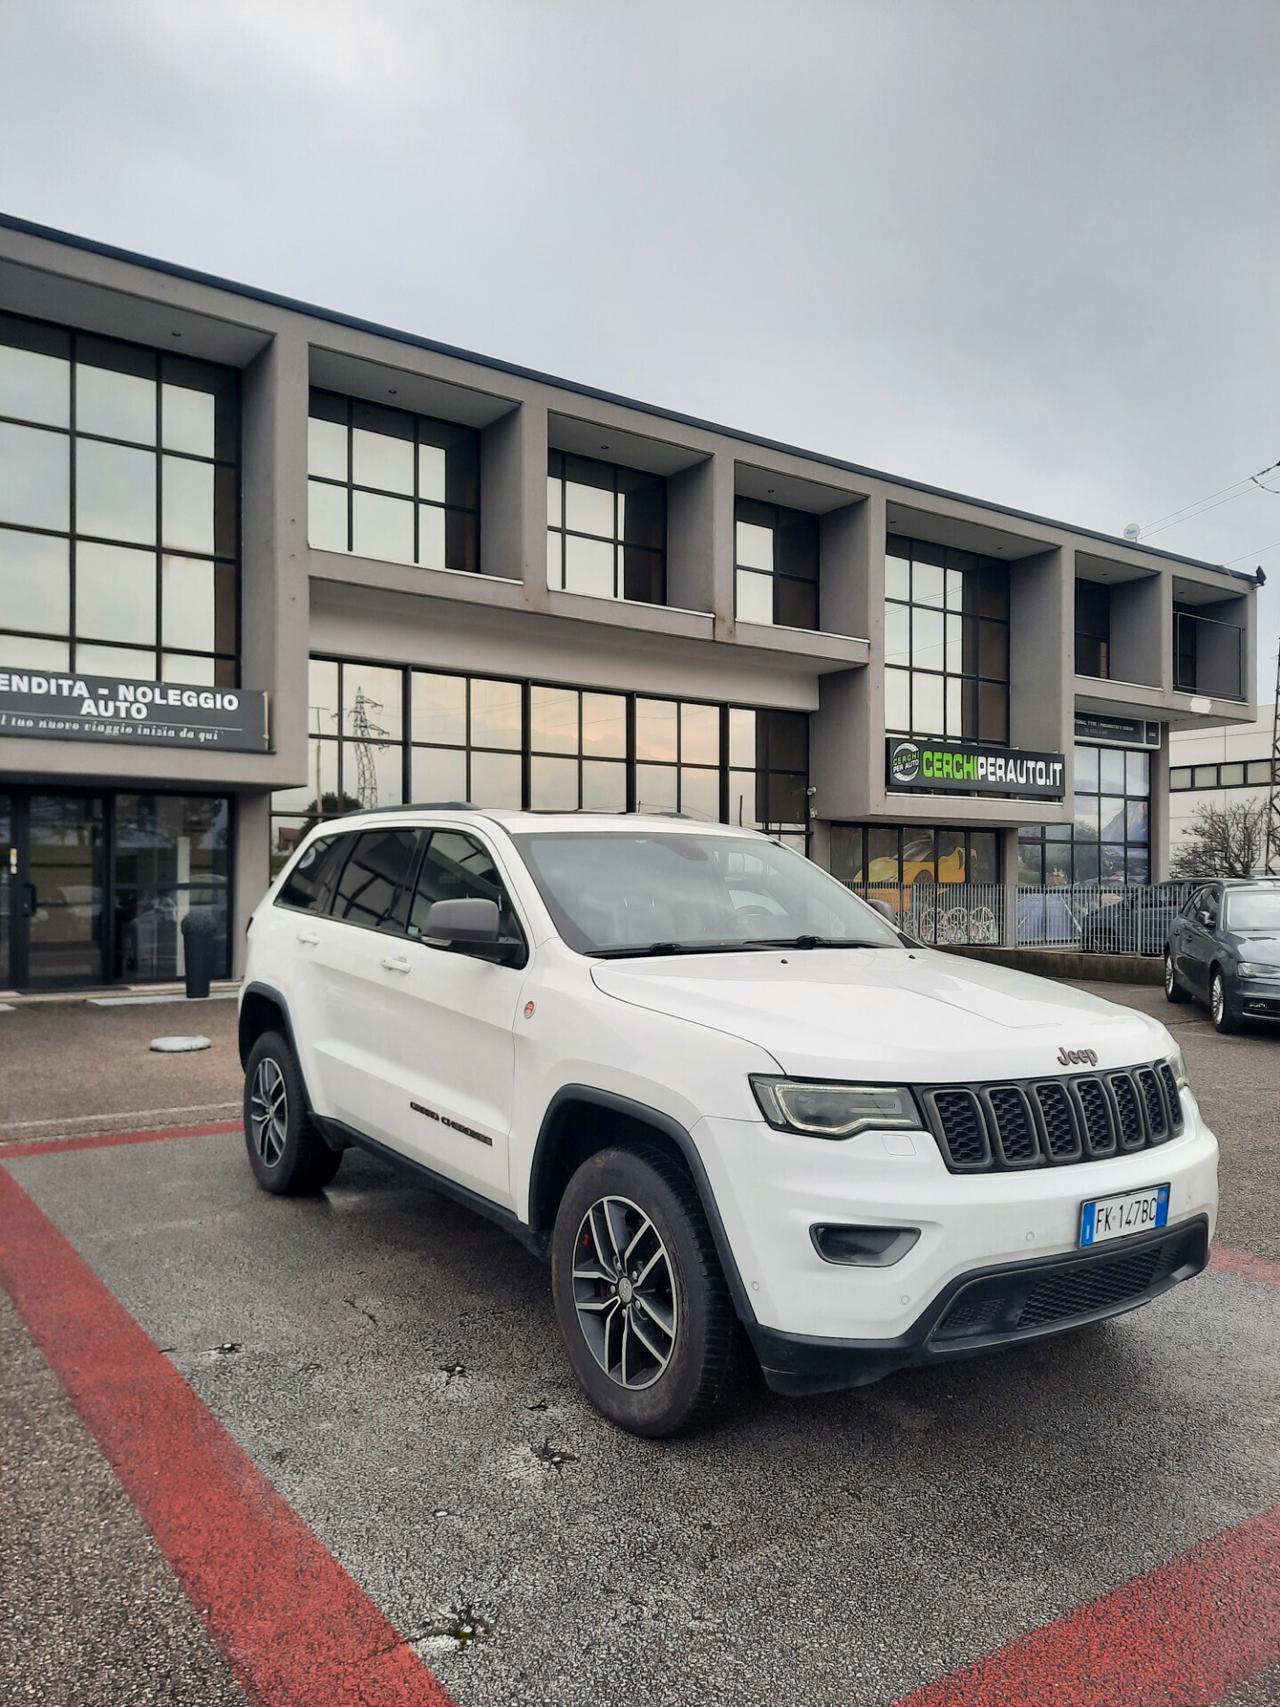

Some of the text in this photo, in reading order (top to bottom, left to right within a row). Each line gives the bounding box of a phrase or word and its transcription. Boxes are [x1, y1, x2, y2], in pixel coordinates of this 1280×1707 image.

[0, 673, 91, 698] ENDITA
[118, 684, 239, 711] NOLEGGIO
[80, 698, 148, 720] AUTO
[11, 716, 34, 728] tuo
[137, 724, 176, 738] inizia
[179, 727, 195, 739] da
[198, 730, 219, 743] qui
[892, 751, 920, 767] CERCHI
[892, 758, 920, 774] PER AUTO
[922, 750, 1063, 787] CERCHIPERAUTO.IT
[1057, 1046, 1098, 1067] Jeep
